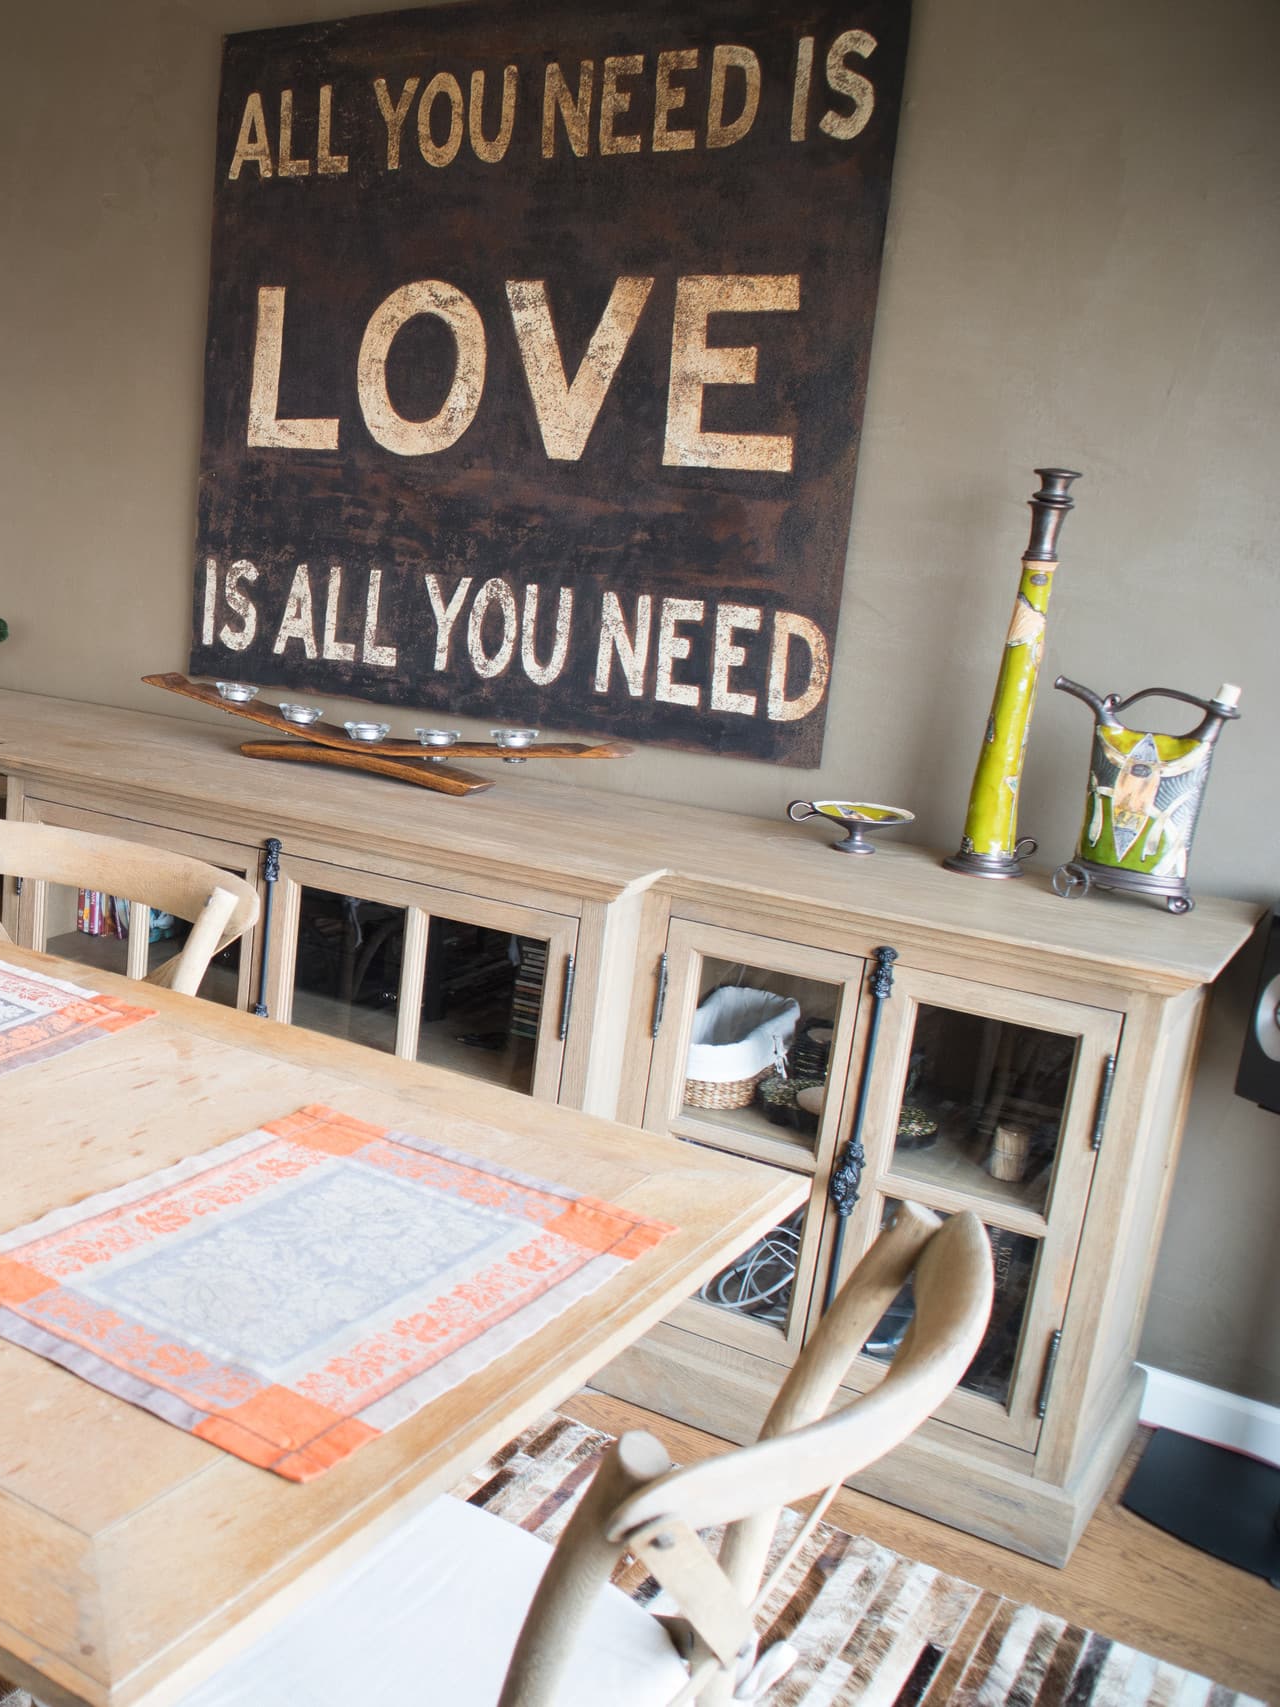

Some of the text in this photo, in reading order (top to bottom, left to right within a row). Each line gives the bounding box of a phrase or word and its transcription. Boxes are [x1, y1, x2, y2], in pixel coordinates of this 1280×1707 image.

[228, 29, 879, 180] ALL YOU NEED IS
[246, 274, 801, 473] LOVE
[201, 558, 830, 721] IS ALL YOU NEED
